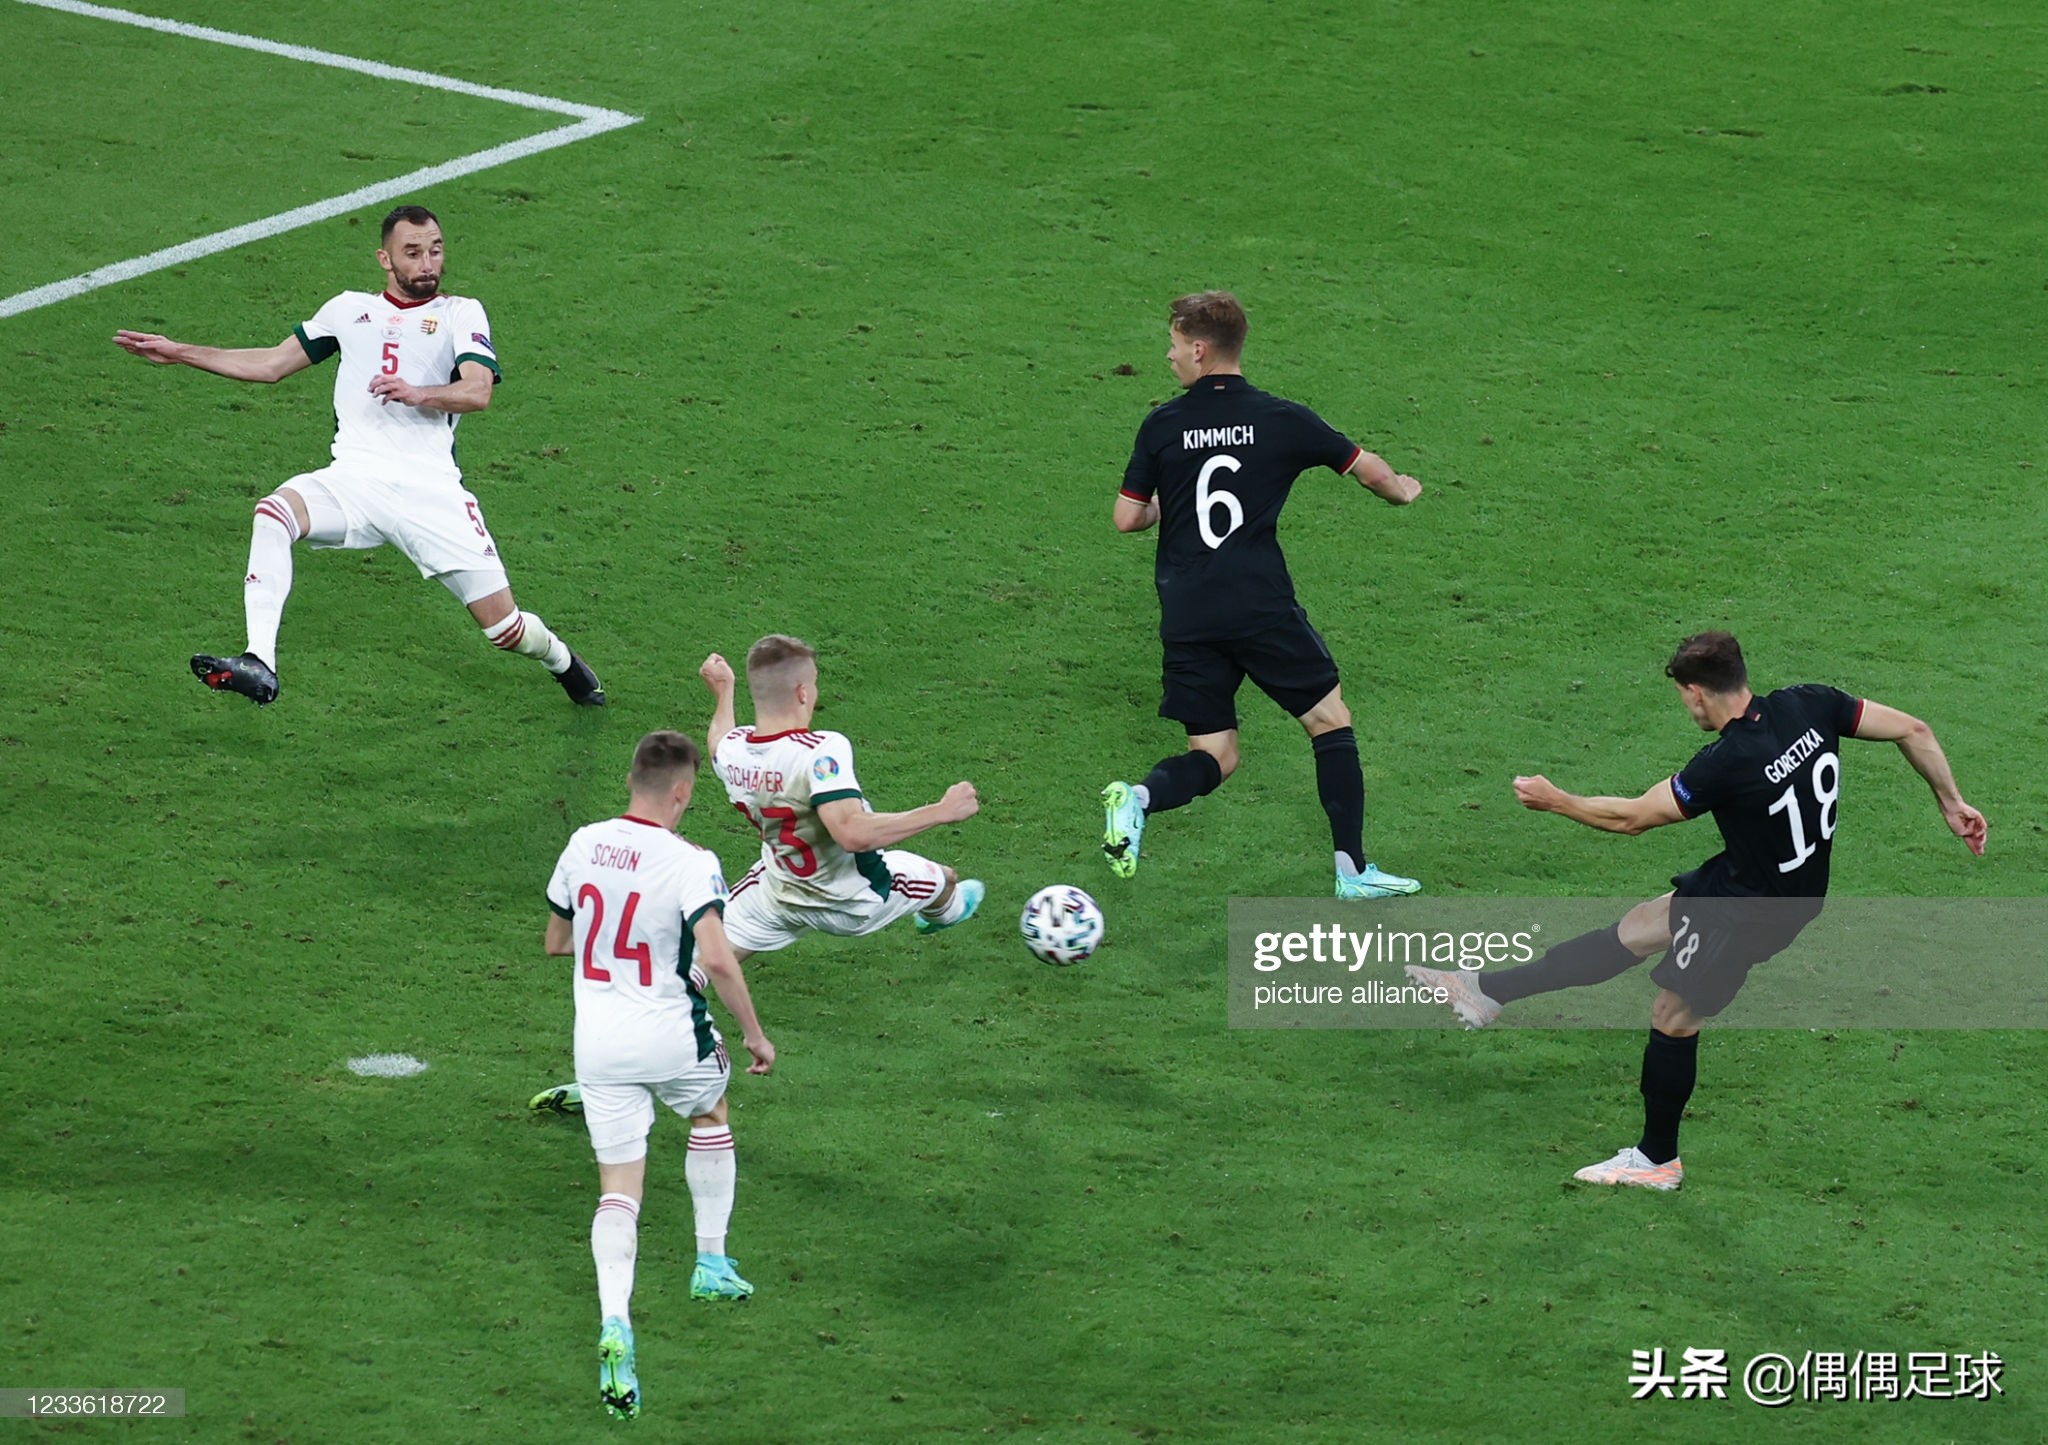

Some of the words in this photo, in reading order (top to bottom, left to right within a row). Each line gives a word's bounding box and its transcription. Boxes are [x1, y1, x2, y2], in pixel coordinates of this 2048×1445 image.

[382, 342, 399, 375] 5
[1183, 424, 1255, 450] KIMMICH
[465, 501, 485, 537] 5
[1195, 454, 1244, 549] 6
[1764, 727, 1824, 784] GORETZKA
[1768, 751, 1840, 873] 18
[591, 843, 642, 873] SCHÖN
[577, 883, 652, 987] 24
[1672, 914, 1699, 970] 18
